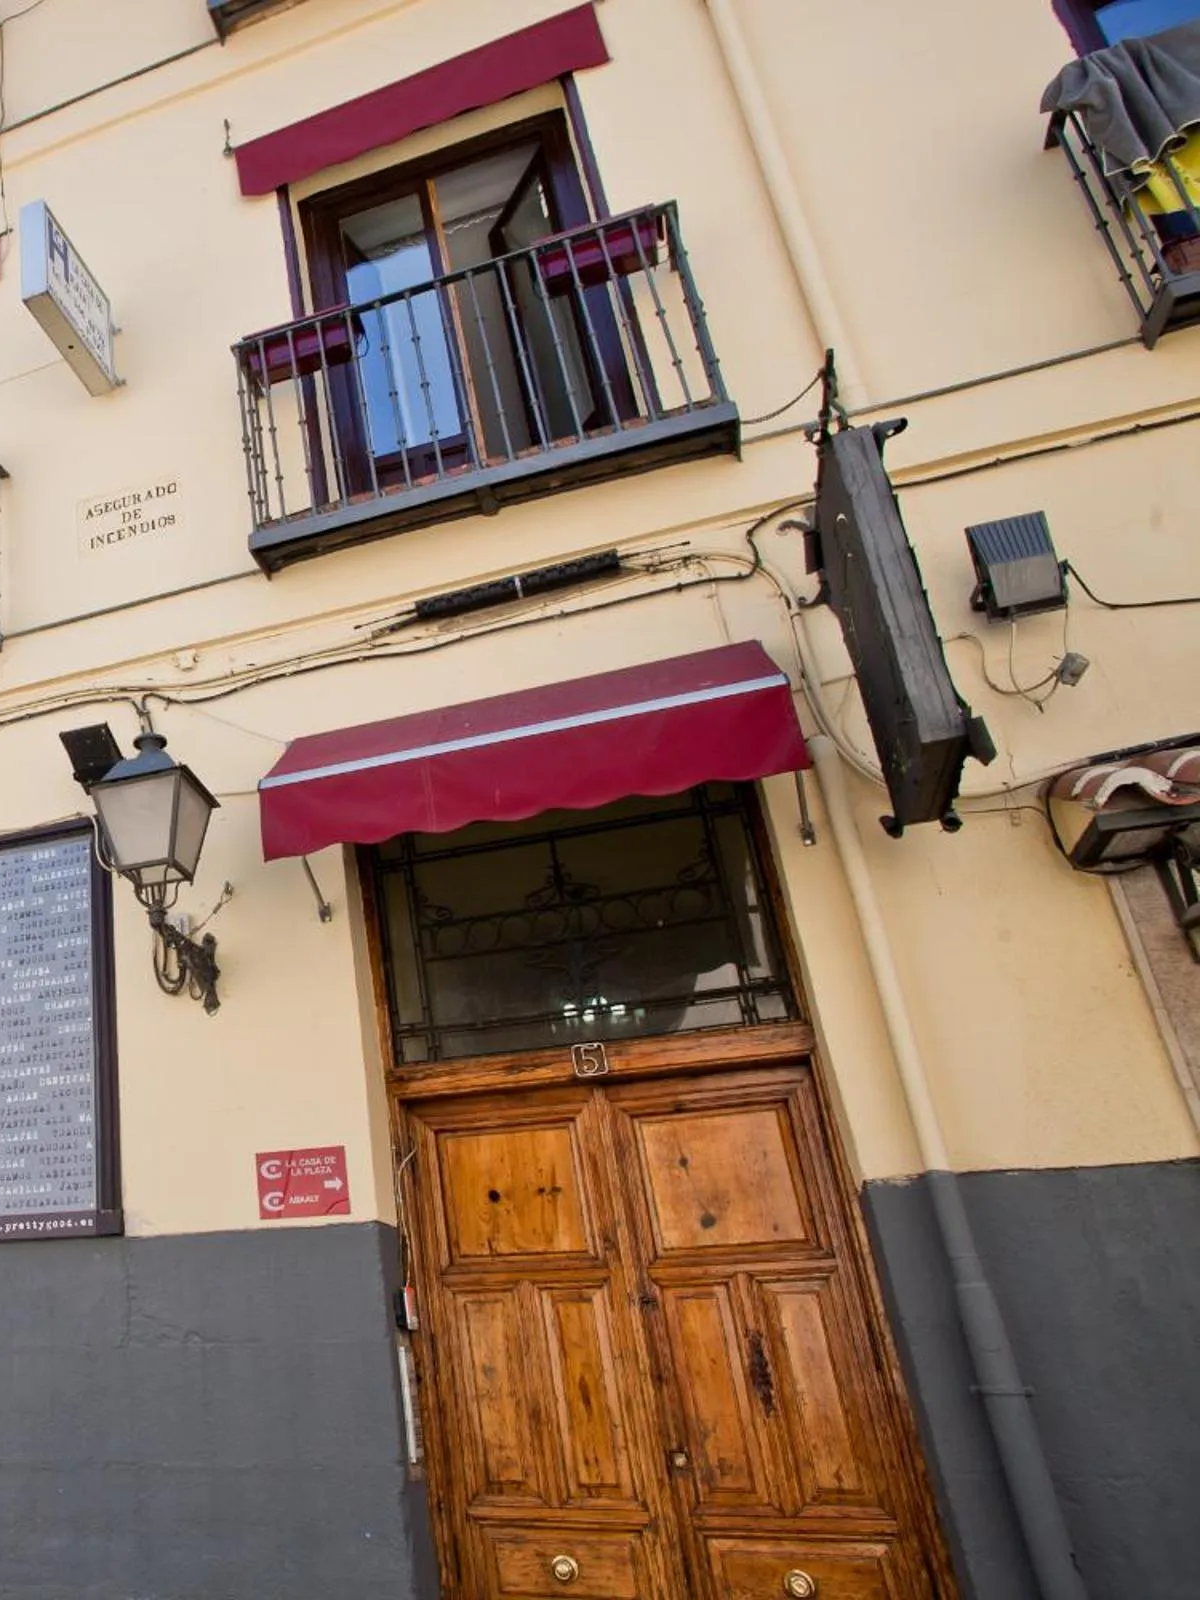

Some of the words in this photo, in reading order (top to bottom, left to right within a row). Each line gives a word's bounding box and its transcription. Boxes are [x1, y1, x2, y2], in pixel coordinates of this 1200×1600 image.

[85, 483, 177, 520] ASEGURADO
[122, 508, 142, 524] DE
[90, 515, 176, 549] INCENDIOS
[580, 1043, 599, 1073] 5
[290, 1168, 302, 1177] LA
[304, 1165, 333, 1175] PLAZA
[299, 1157, 322, 1166] CASA
[324, 1156, 337, 1164] DE
